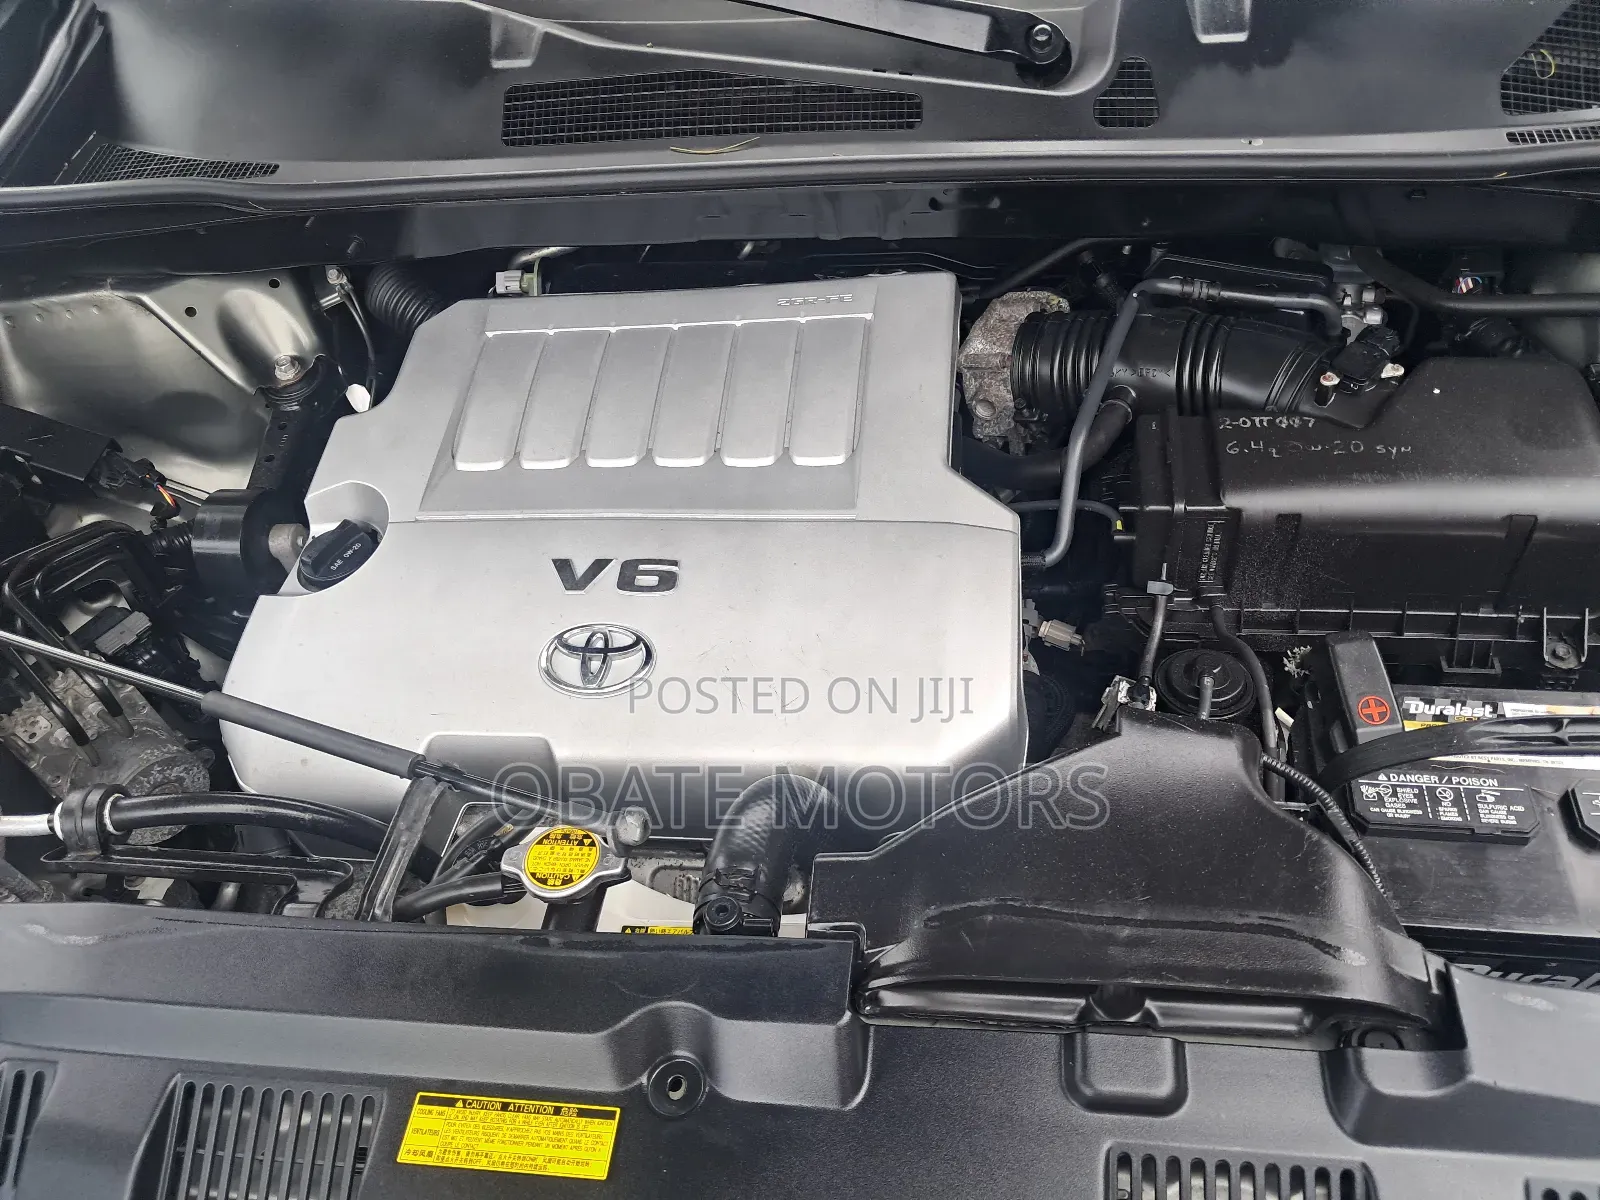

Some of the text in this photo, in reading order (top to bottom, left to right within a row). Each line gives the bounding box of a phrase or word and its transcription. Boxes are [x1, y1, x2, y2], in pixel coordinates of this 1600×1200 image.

[331, 559, 343, 570] SAE
[551, 559, 680, 596] V6
[1404, 700, 1494, 718] Duralast
[1390, 773, 1439, 783] DANGER
[1452, 776, 1498, 786] POISON
[466, 1100, 502, 1110] CAUTION
[508, 1103, 554, 1114] ATTENTION
[411, 1128, 440, 1136] VENTILATEURS
